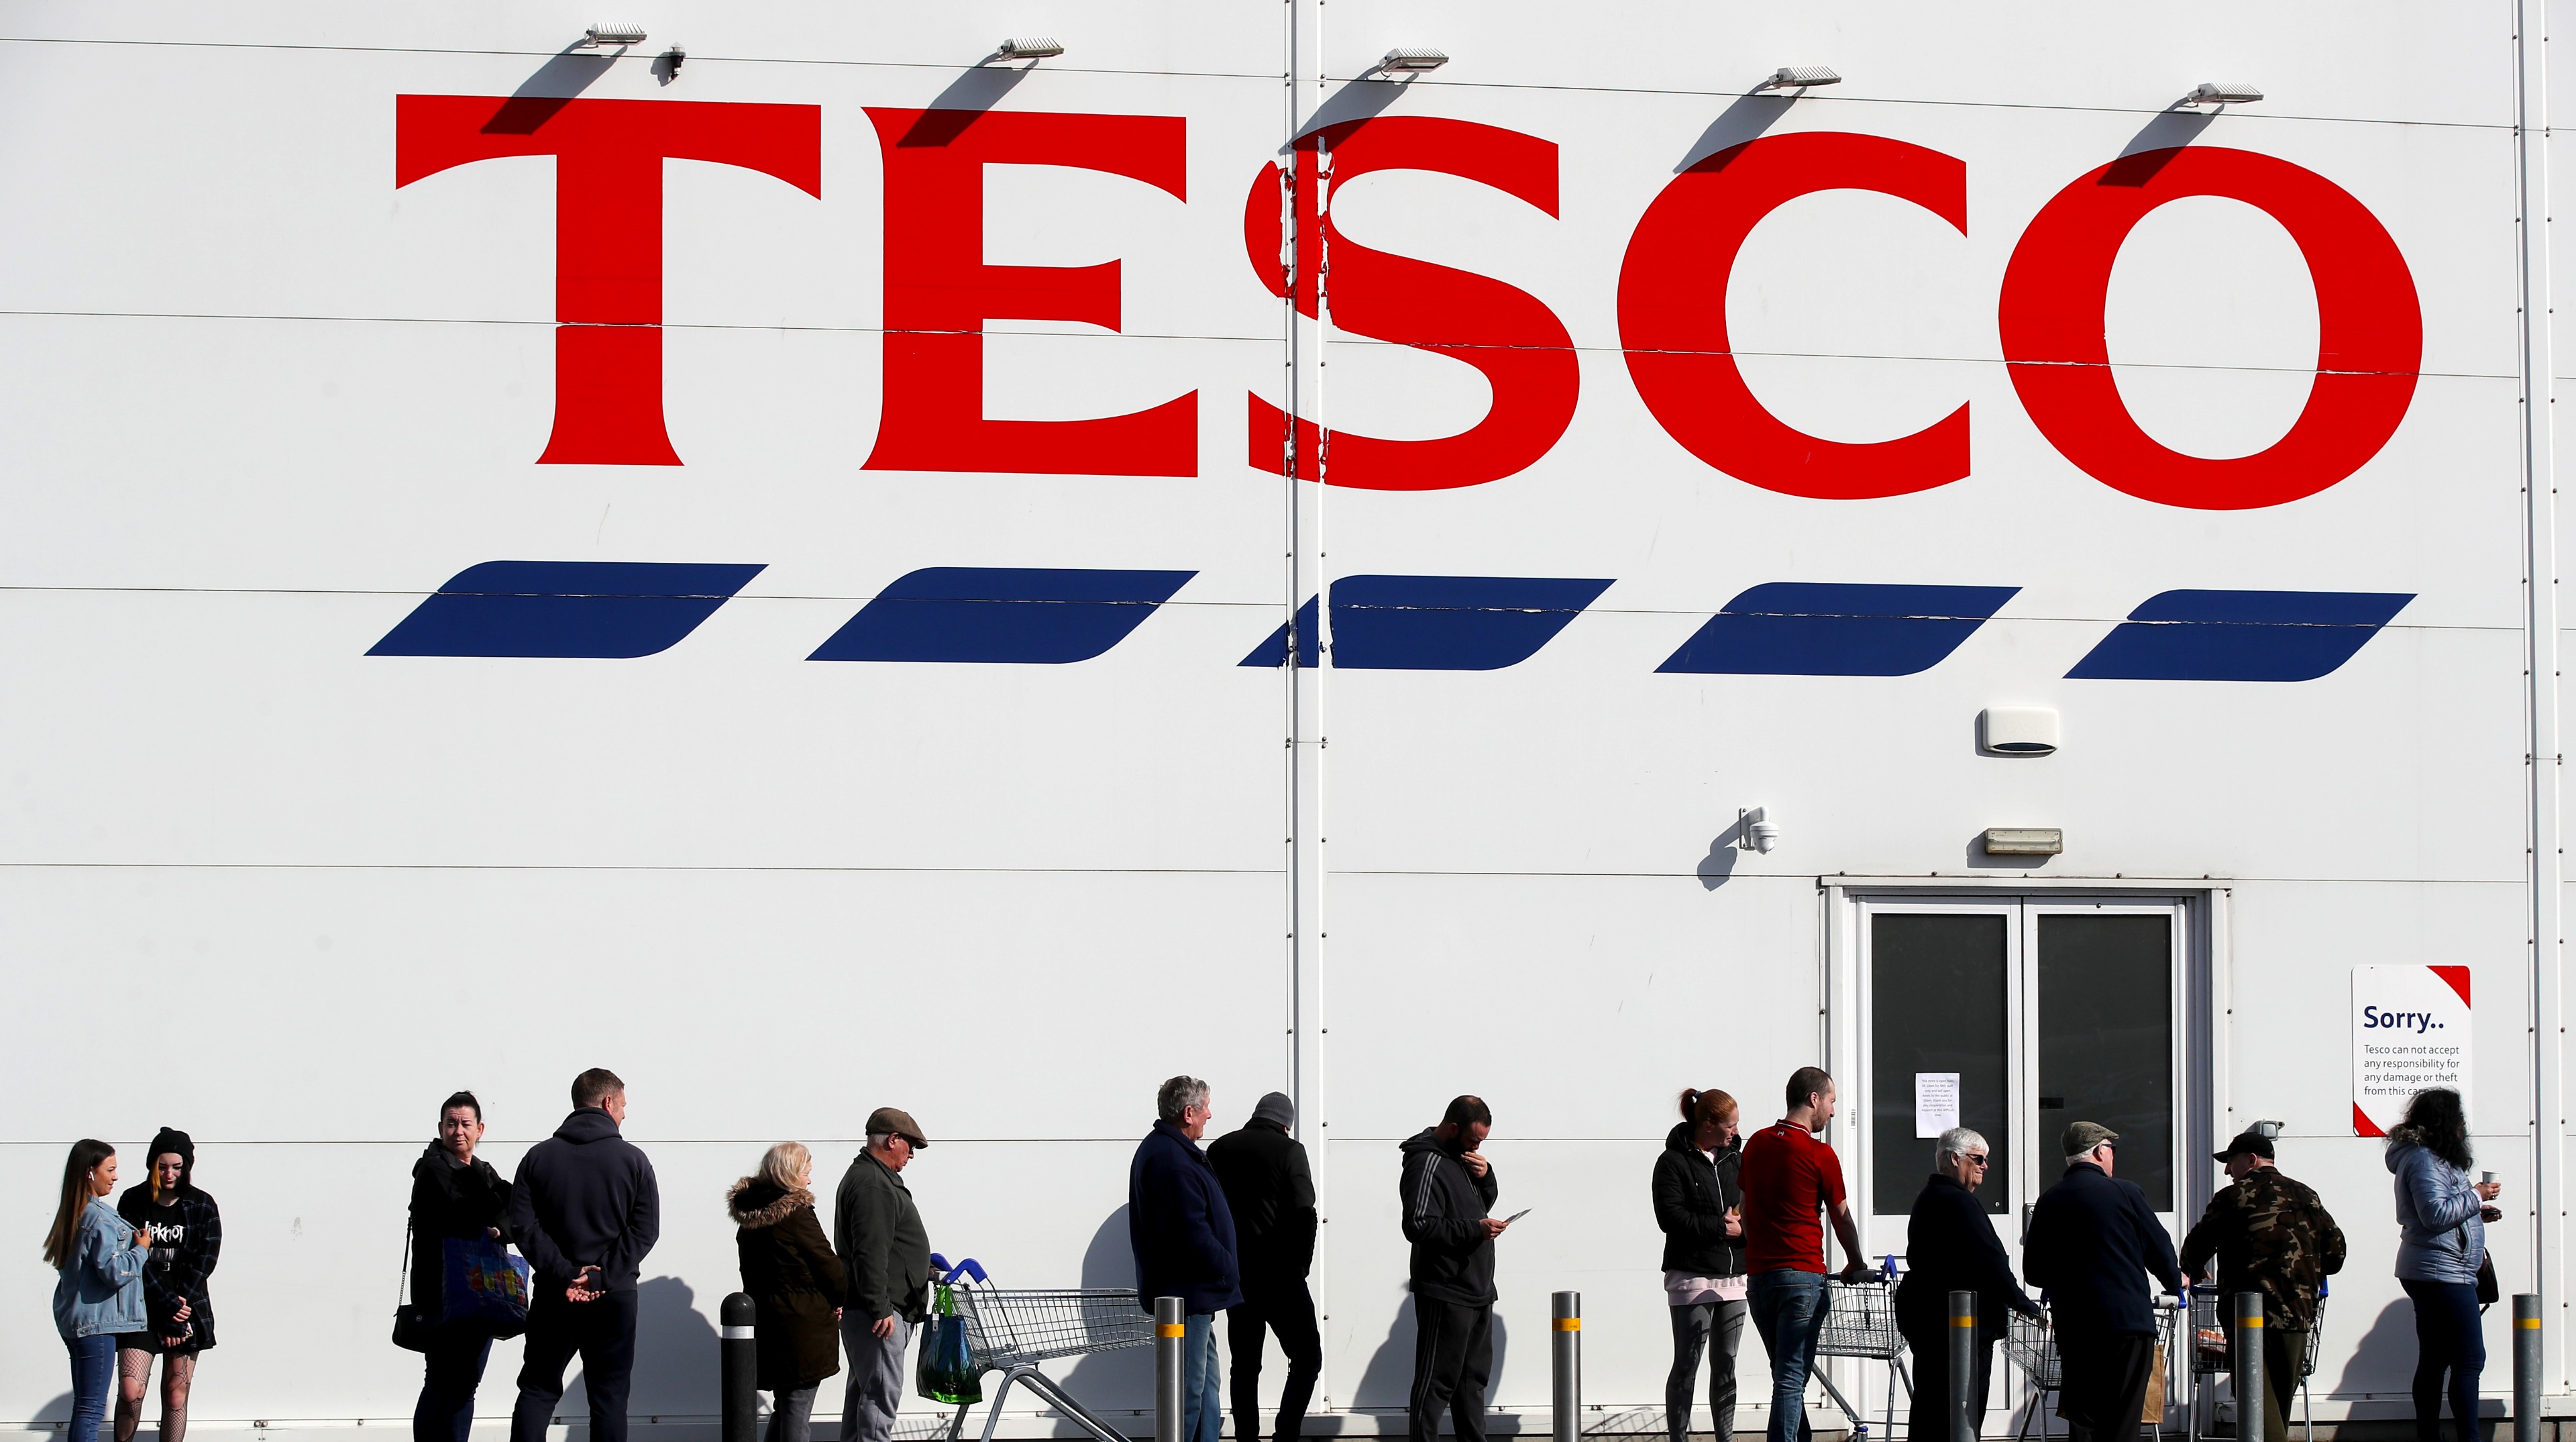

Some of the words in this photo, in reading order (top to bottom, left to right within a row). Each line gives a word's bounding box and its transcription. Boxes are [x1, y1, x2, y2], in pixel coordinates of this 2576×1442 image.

[396, 95, 2422, 510] TESCO
[2363, 1005, 2445, 1035] Sorry..
[2364, 1045, 2390, 1054] Tesco
[2411, 1045, 2426, 1054] not
[2428, 1045, 2460, 1056] accept
[2364, 1060, 2381, 1070] any
[2383, 1058, 2445, 1070] responsibility
[2447, 1058, 2460, 1068] for
[2364, 1074, 2381, 1084] any
[2383, 1072, 2422, 1084] damage
[2435, 1072, 2459, 1082] theft
[2364, 1086, 2386, 1096] from
[2388, 1086, 2406, 1096] this
